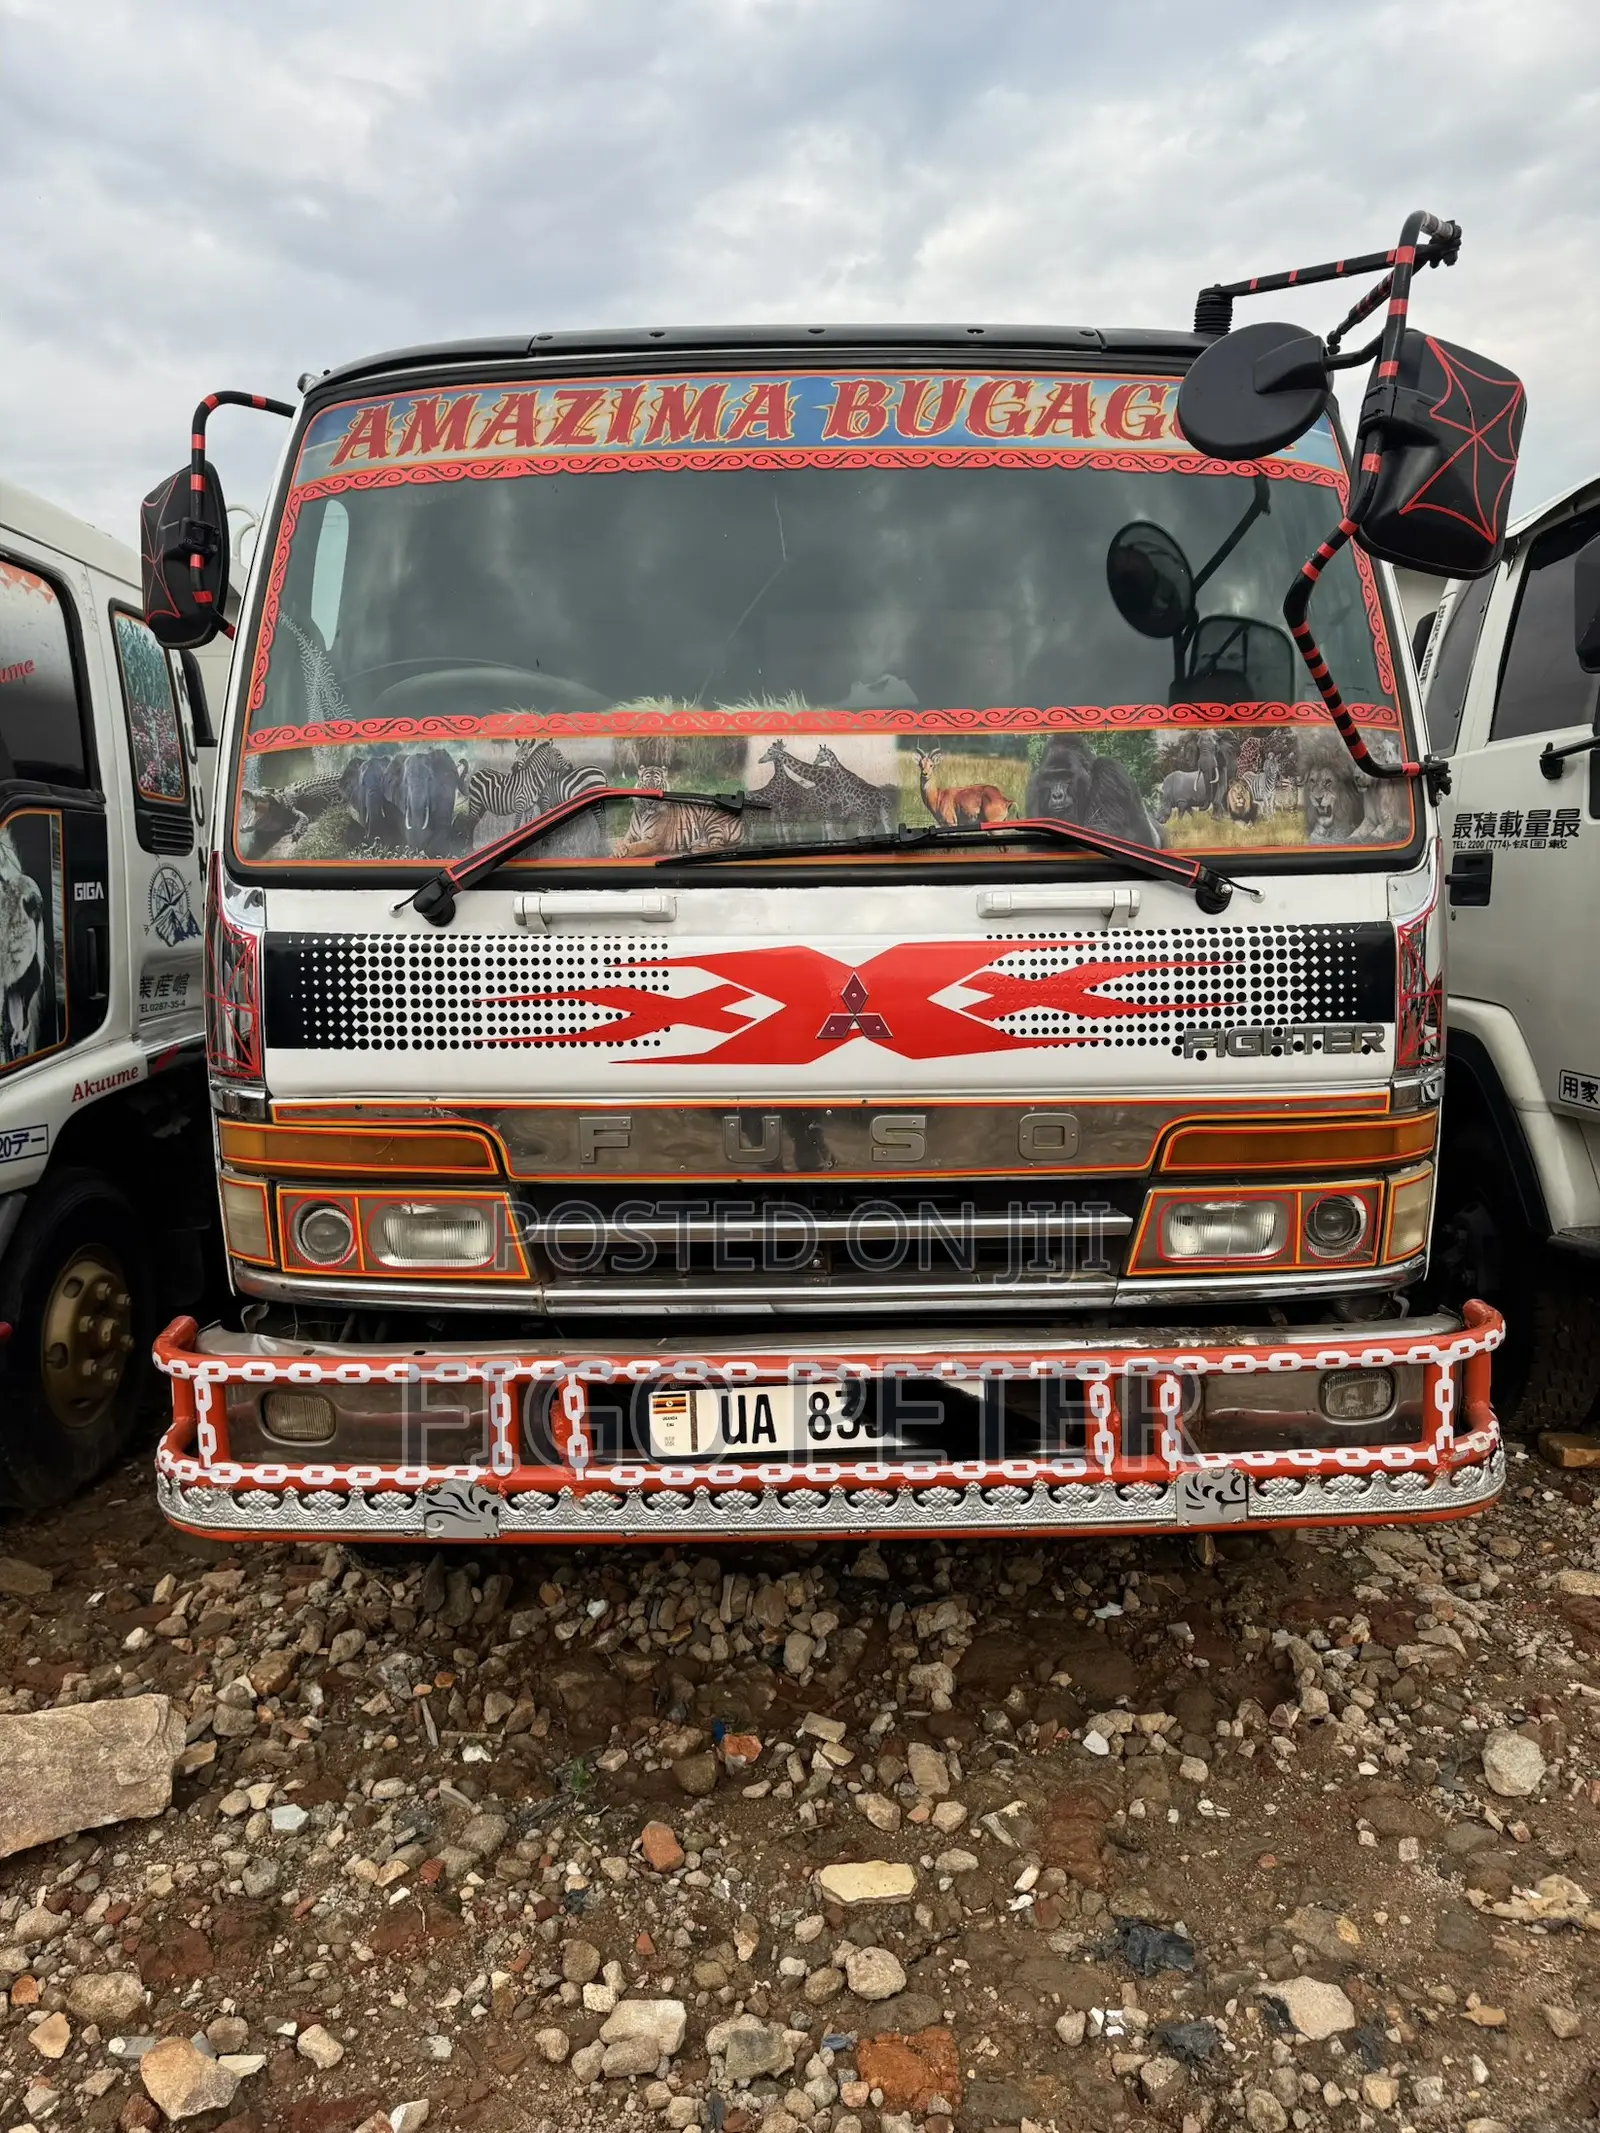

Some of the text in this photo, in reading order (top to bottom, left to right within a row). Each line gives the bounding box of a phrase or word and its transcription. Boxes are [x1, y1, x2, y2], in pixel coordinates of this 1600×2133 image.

[327, 378, 1188, 468] AMAZIMA BUGAG
[1468, 840, 1485, 849] 2200
[74, 881, 105, 901] GIGA
[1184, 1024, 1386, 1059] FIGHTER
[71, 1066, 139, 1103] Akuume
[578, 1113, 1080, 1165] FUSO
[720, 1393, 777, 1445] UA
